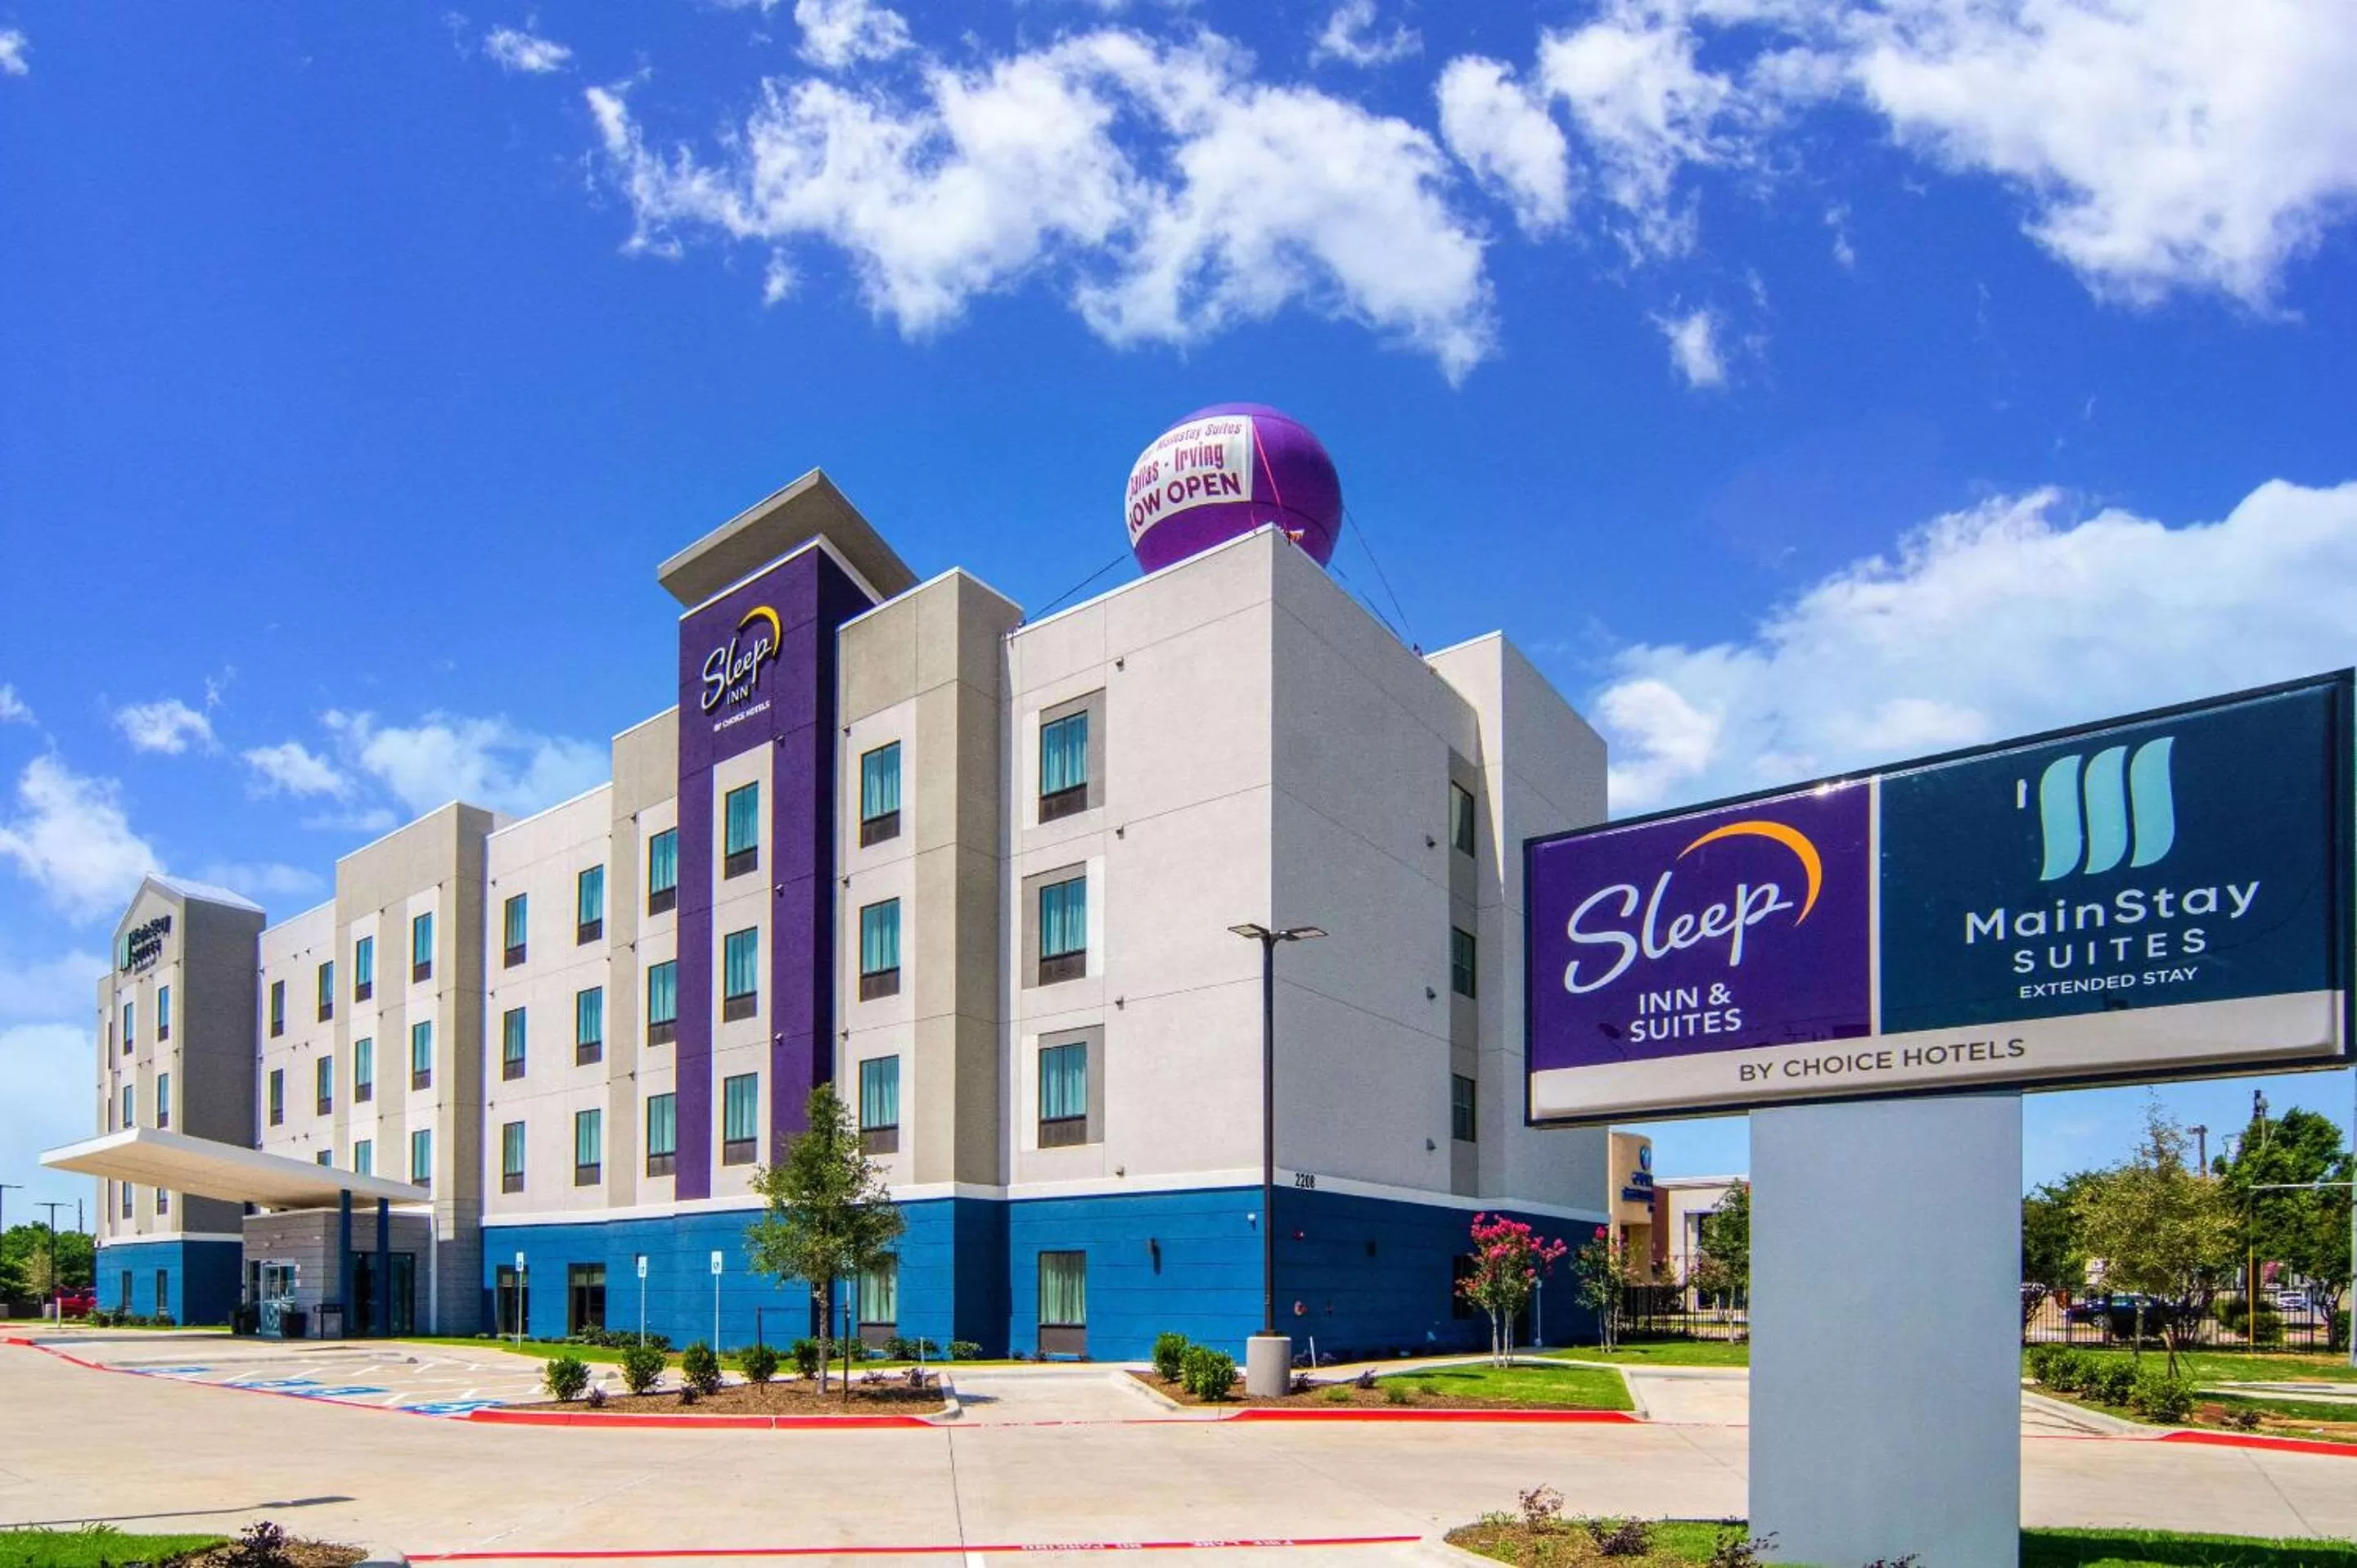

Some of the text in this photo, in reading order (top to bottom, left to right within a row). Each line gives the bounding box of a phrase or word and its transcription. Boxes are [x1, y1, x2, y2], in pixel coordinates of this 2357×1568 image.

[1205, 422, 1242, 436] Suites
[1174, 442, 1224, 471] Irving
[1167, 472, 1242, 503] OPEN
[701, 637, 772, 710] Sleep
[727, 685, 749, 705] INN
[1965, 881, 2260, 944] MainStay
[1564, 871, 1793, 994] Sleep
[2012, 928, 2206, 974] SUITES
[1639, 982, 1732, 1015] INN &
[2019, 966, 2199, 999] EXTENDED STAY
[1630, 1008, 1742, 1043] SUITES
[1740, 1039, 2026, 1082] BY CHOICE HOTELS
